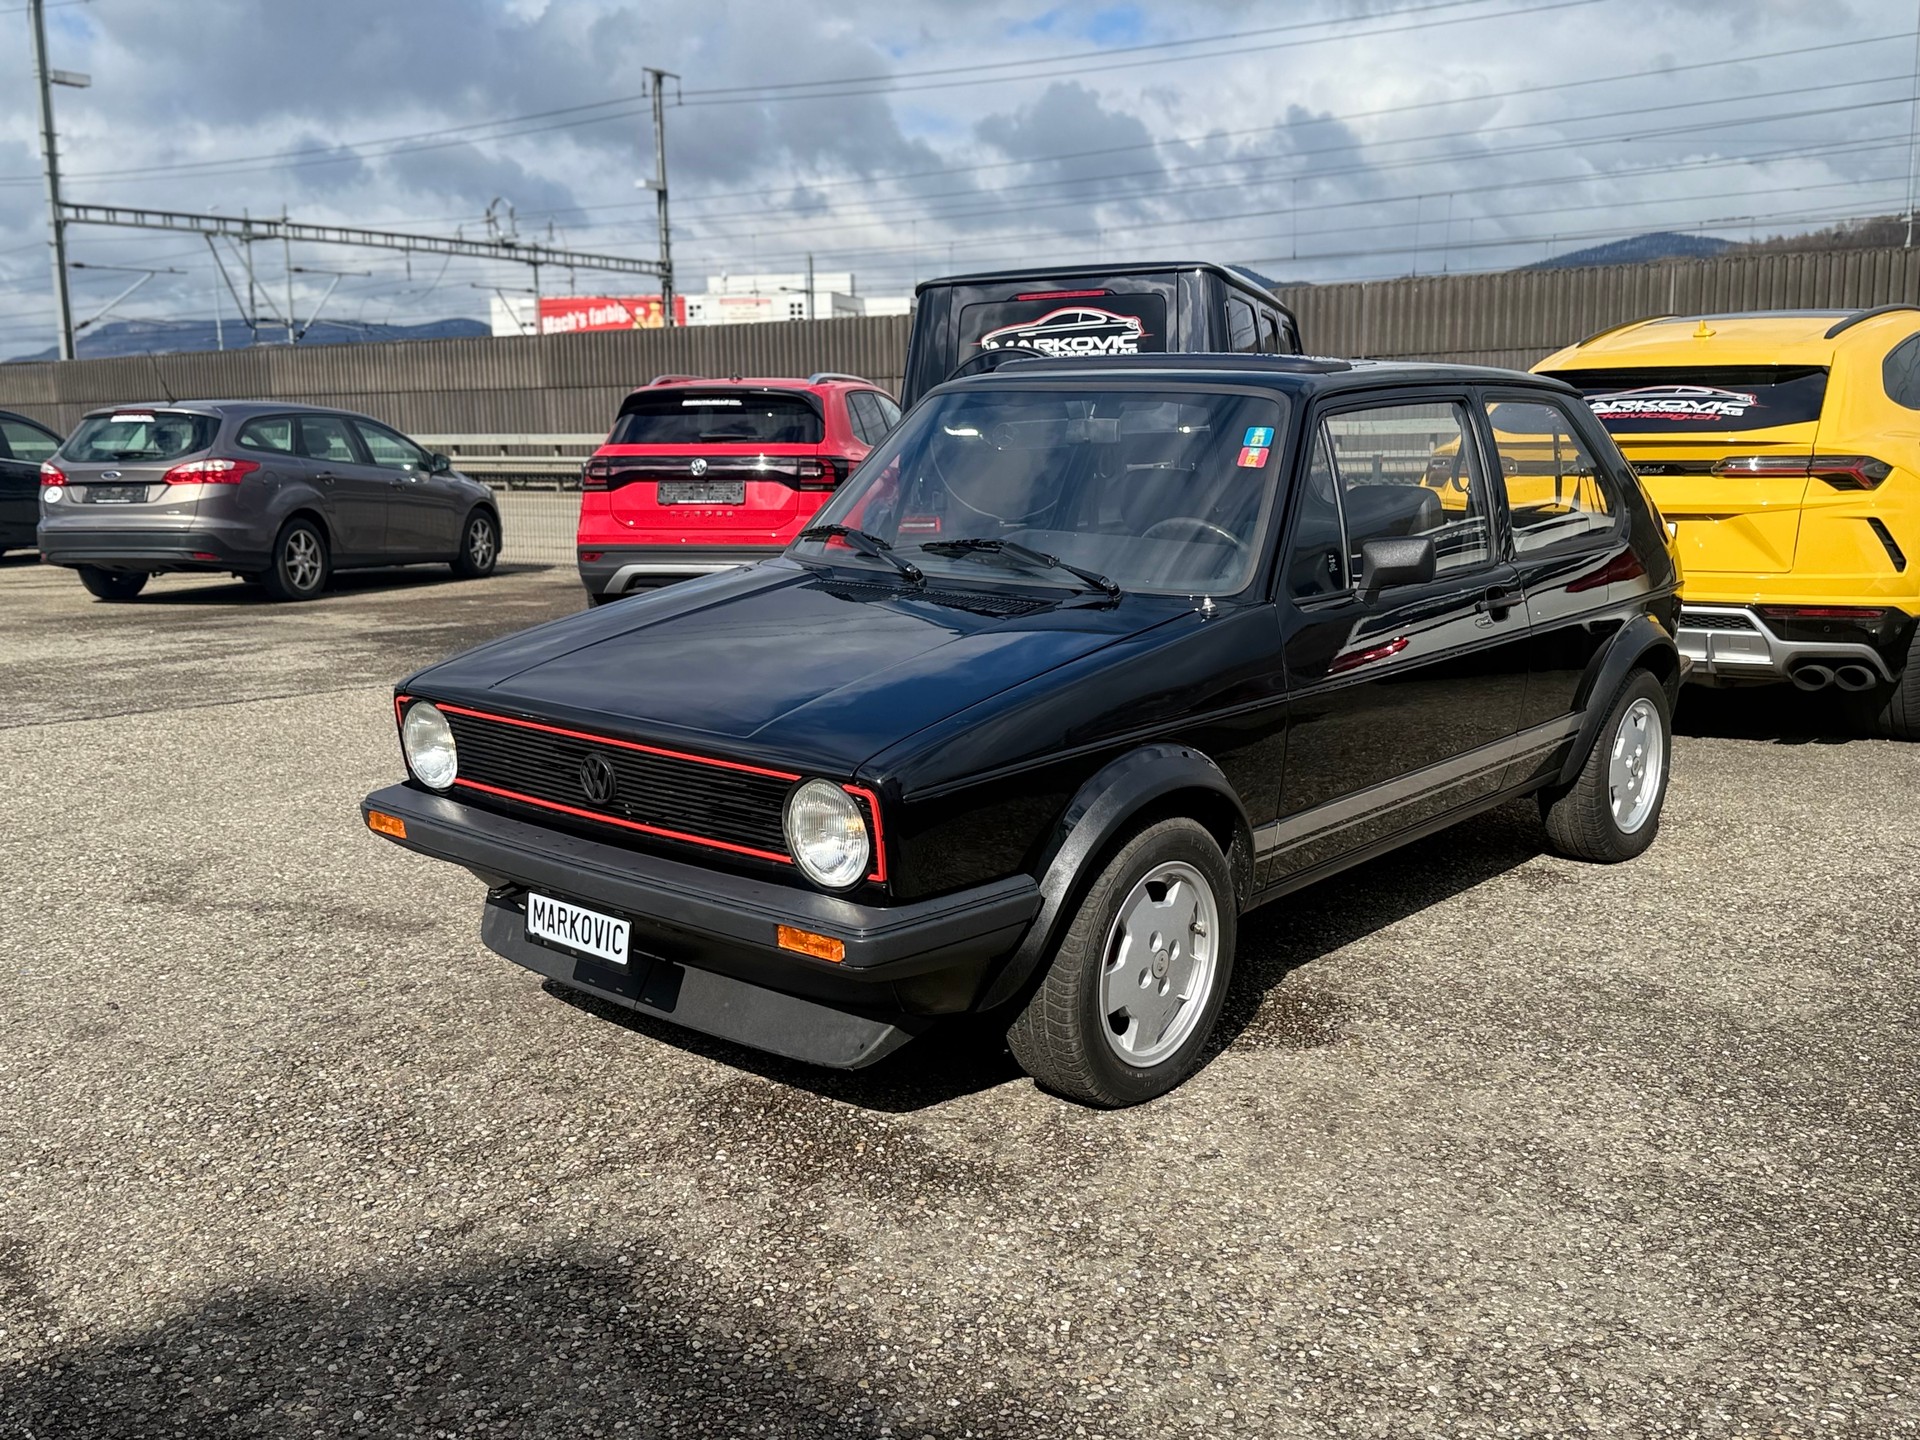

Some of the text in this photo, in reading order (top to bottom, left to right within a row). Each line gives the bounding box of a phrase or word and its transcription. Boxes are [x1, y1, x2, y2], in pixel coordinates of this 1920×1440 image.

[542, 311, 588, 335] Mach's
[1589, 400, 1749, 412] ARKOVIC
[533, 898, 624, 955] MARKOVIC
